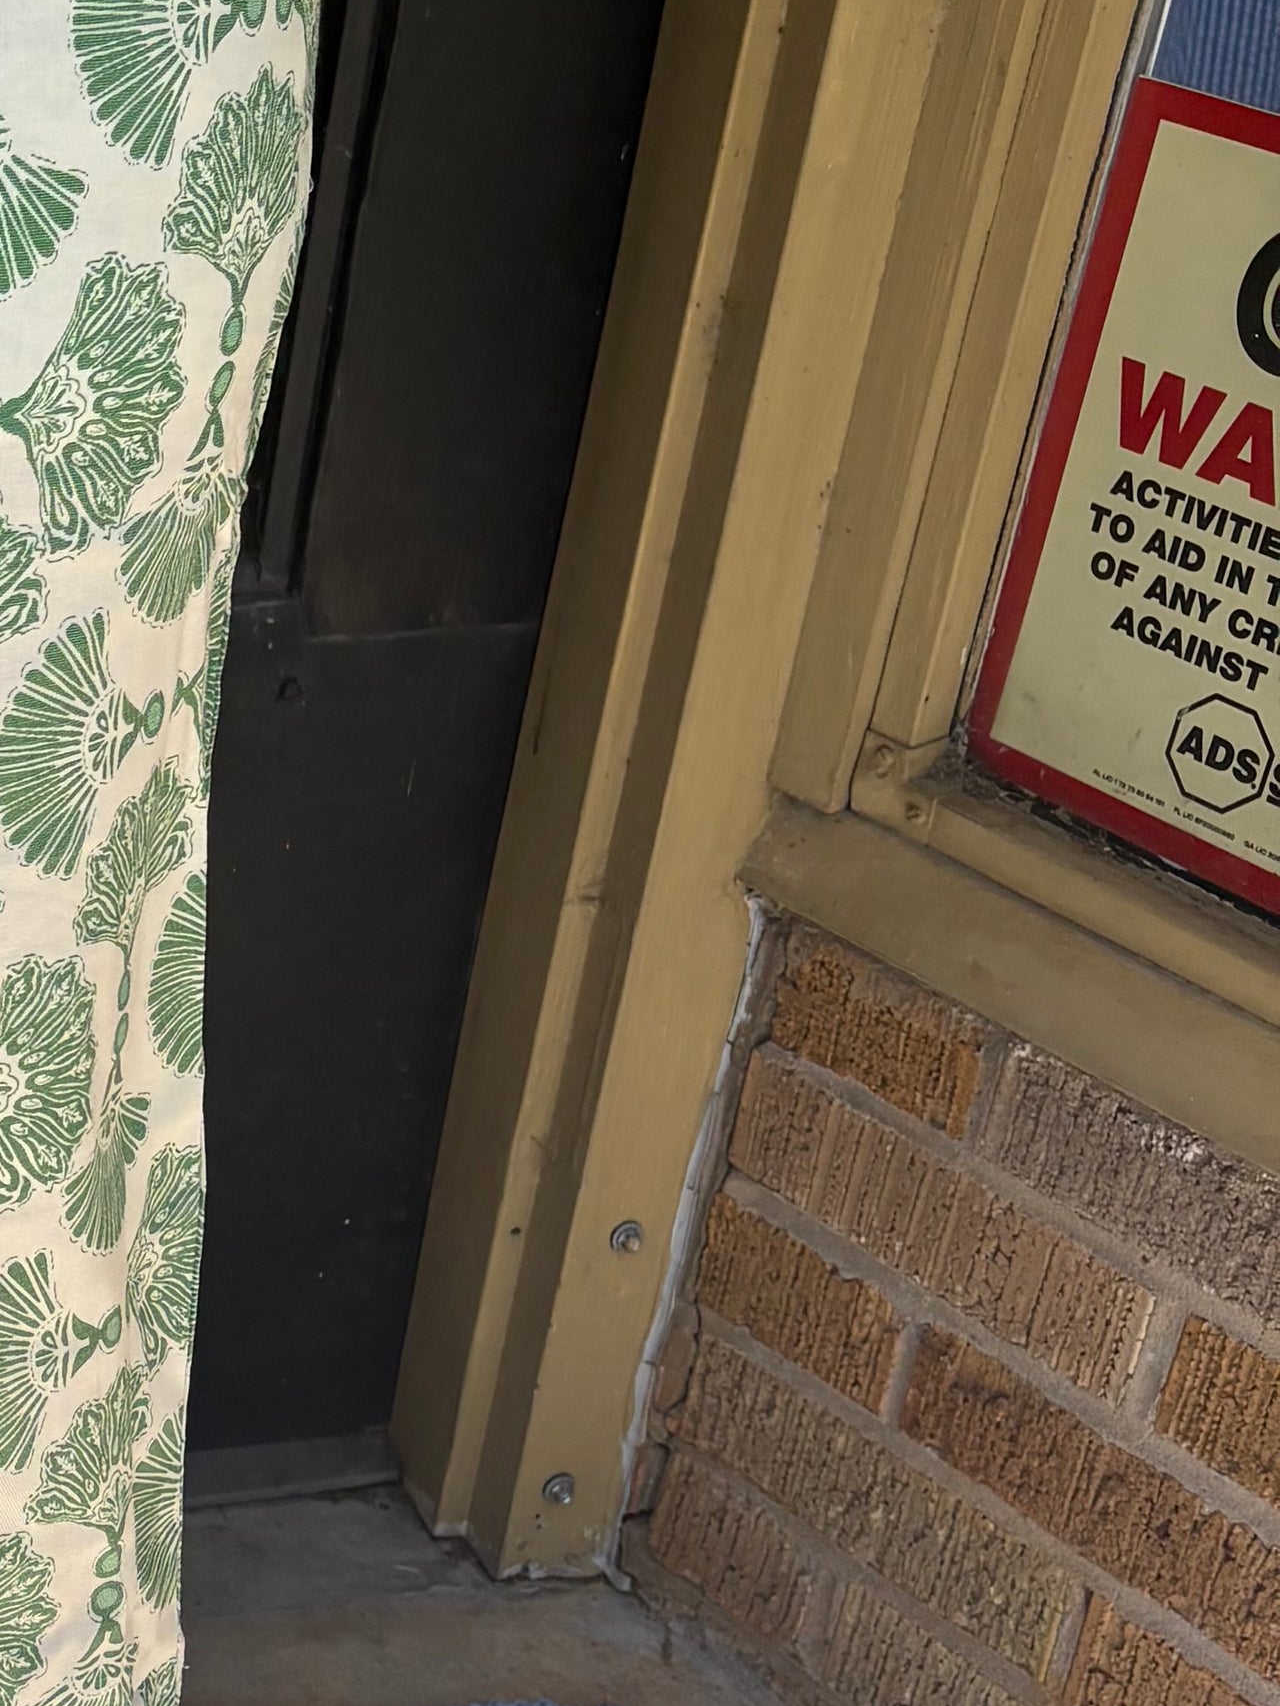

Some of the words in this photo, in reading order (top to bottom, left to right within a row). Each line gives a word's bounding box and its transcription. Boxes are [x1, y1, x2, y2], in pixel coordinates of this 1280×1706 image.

[1090, 502, 1135, 543] TO
[1142, 528, 1206, 572] AID
[1214, 555, 1255, 595] IN
[1110, 470, 1280, 561] ACTIVITIE
[1091, 551, 1139, 588] OF
[1143, 574, 1222, 623] ANY
[1228, 608, 1280, 656] CR
[1110, 606, 1269, 691] AGAINST
